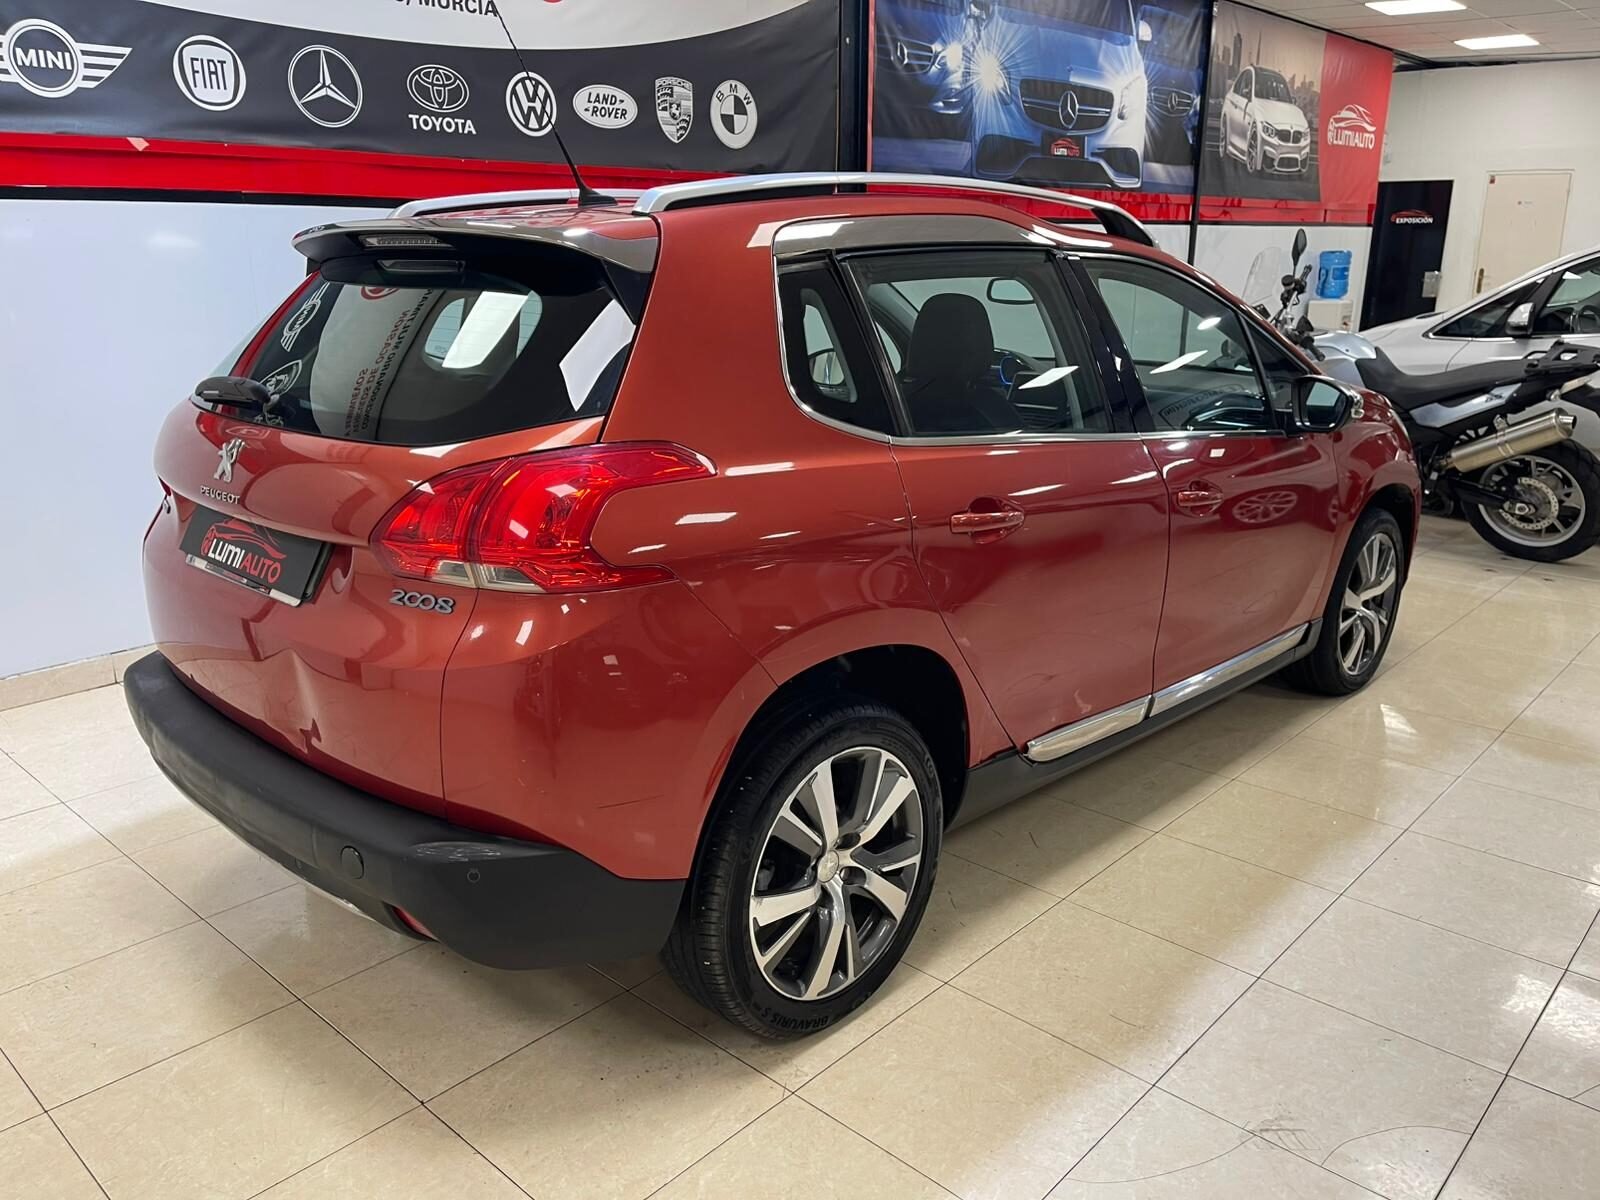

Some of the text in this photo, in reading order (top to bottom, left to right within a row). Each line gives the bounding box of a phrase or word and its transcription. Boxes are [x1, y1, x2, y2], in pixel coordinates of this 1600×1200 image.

[15, 47, 72, 70] MINI
[190, 57, 228, 91] FIAT
[587, 91, 617, 106] LAND
[716, 83, 752, 105] BMW
[591, 106, 628, 120] ROVER
[408, 114, 477, 135] TOYOTA
[200, 485, 241, 505] PEUGEOT
[208, 538, 281, 584] LUMIAUTO
[389, 589, 456, 615] 2008
